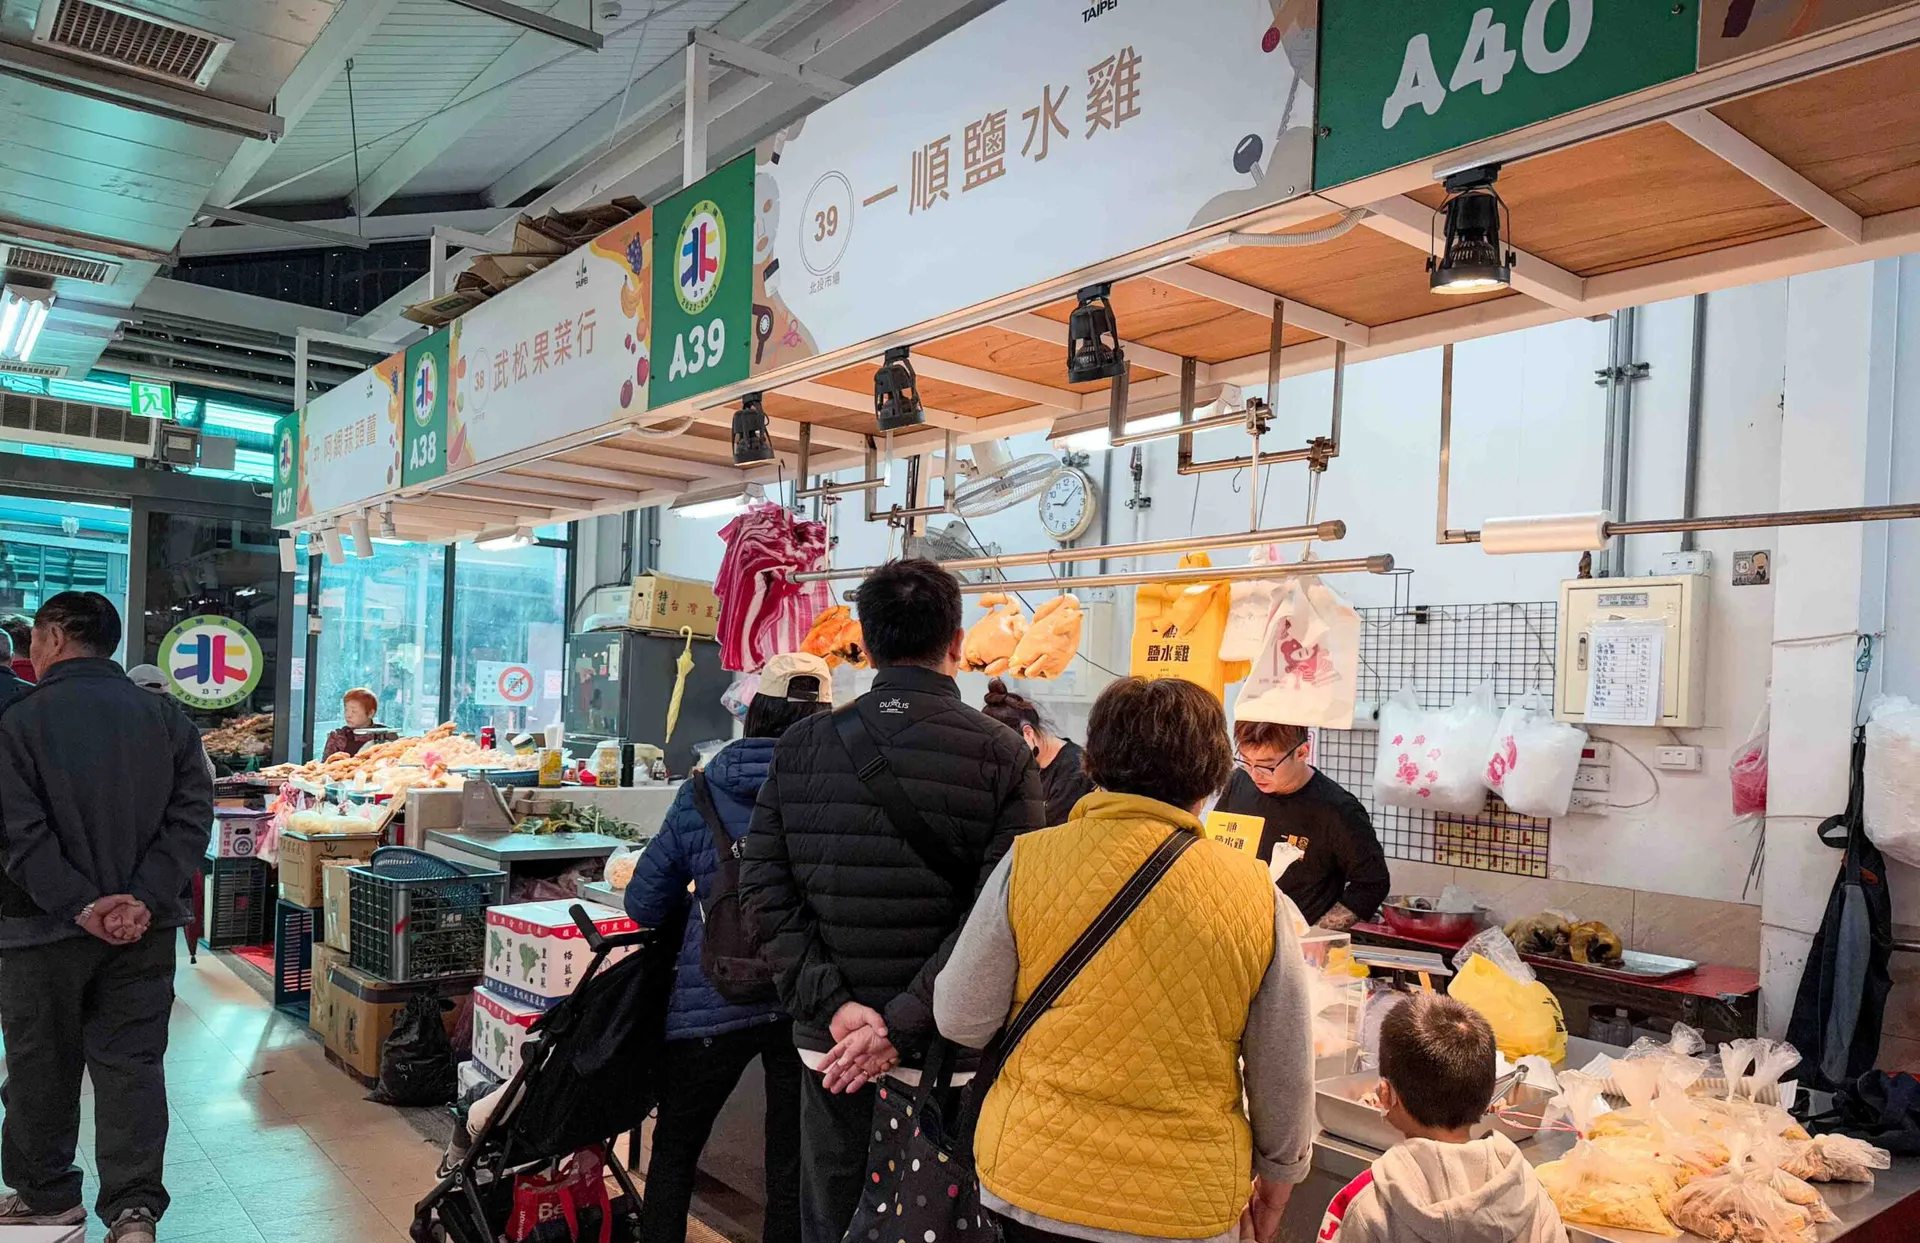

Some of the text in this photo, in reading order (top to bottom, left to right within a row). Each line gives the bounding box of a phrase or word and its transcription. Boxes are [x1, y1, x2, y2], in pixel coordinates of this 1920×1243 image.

[1081, 0, 1118, 23] TAIPEI
[1381, 0, 1594, 130] A40
[862, 45, 1143, 215] 一順鹽水雞
[814, 205, 838, 242] 39
[493, 308, 597, 392] 武松果菜行
[668, 318, 725, 382] A39
[475, 370, 484, 392] 38
[410, 431, 437, 471] A38
[1063, 478, 1069, 487] 12
[276, 488, 293, 515] A37
[1049, 490, 1057, 499] 10
[1046, 502, 1051, 510] 9
[1055, 520, 1059, 528] 7
[1062, 522, 1067, 530] 6
[1070, 518, 1075, 527] 5
[1147, 644, 1190, 662] 鹽水雞
[176, 689, 247, 706] 2022-2023
